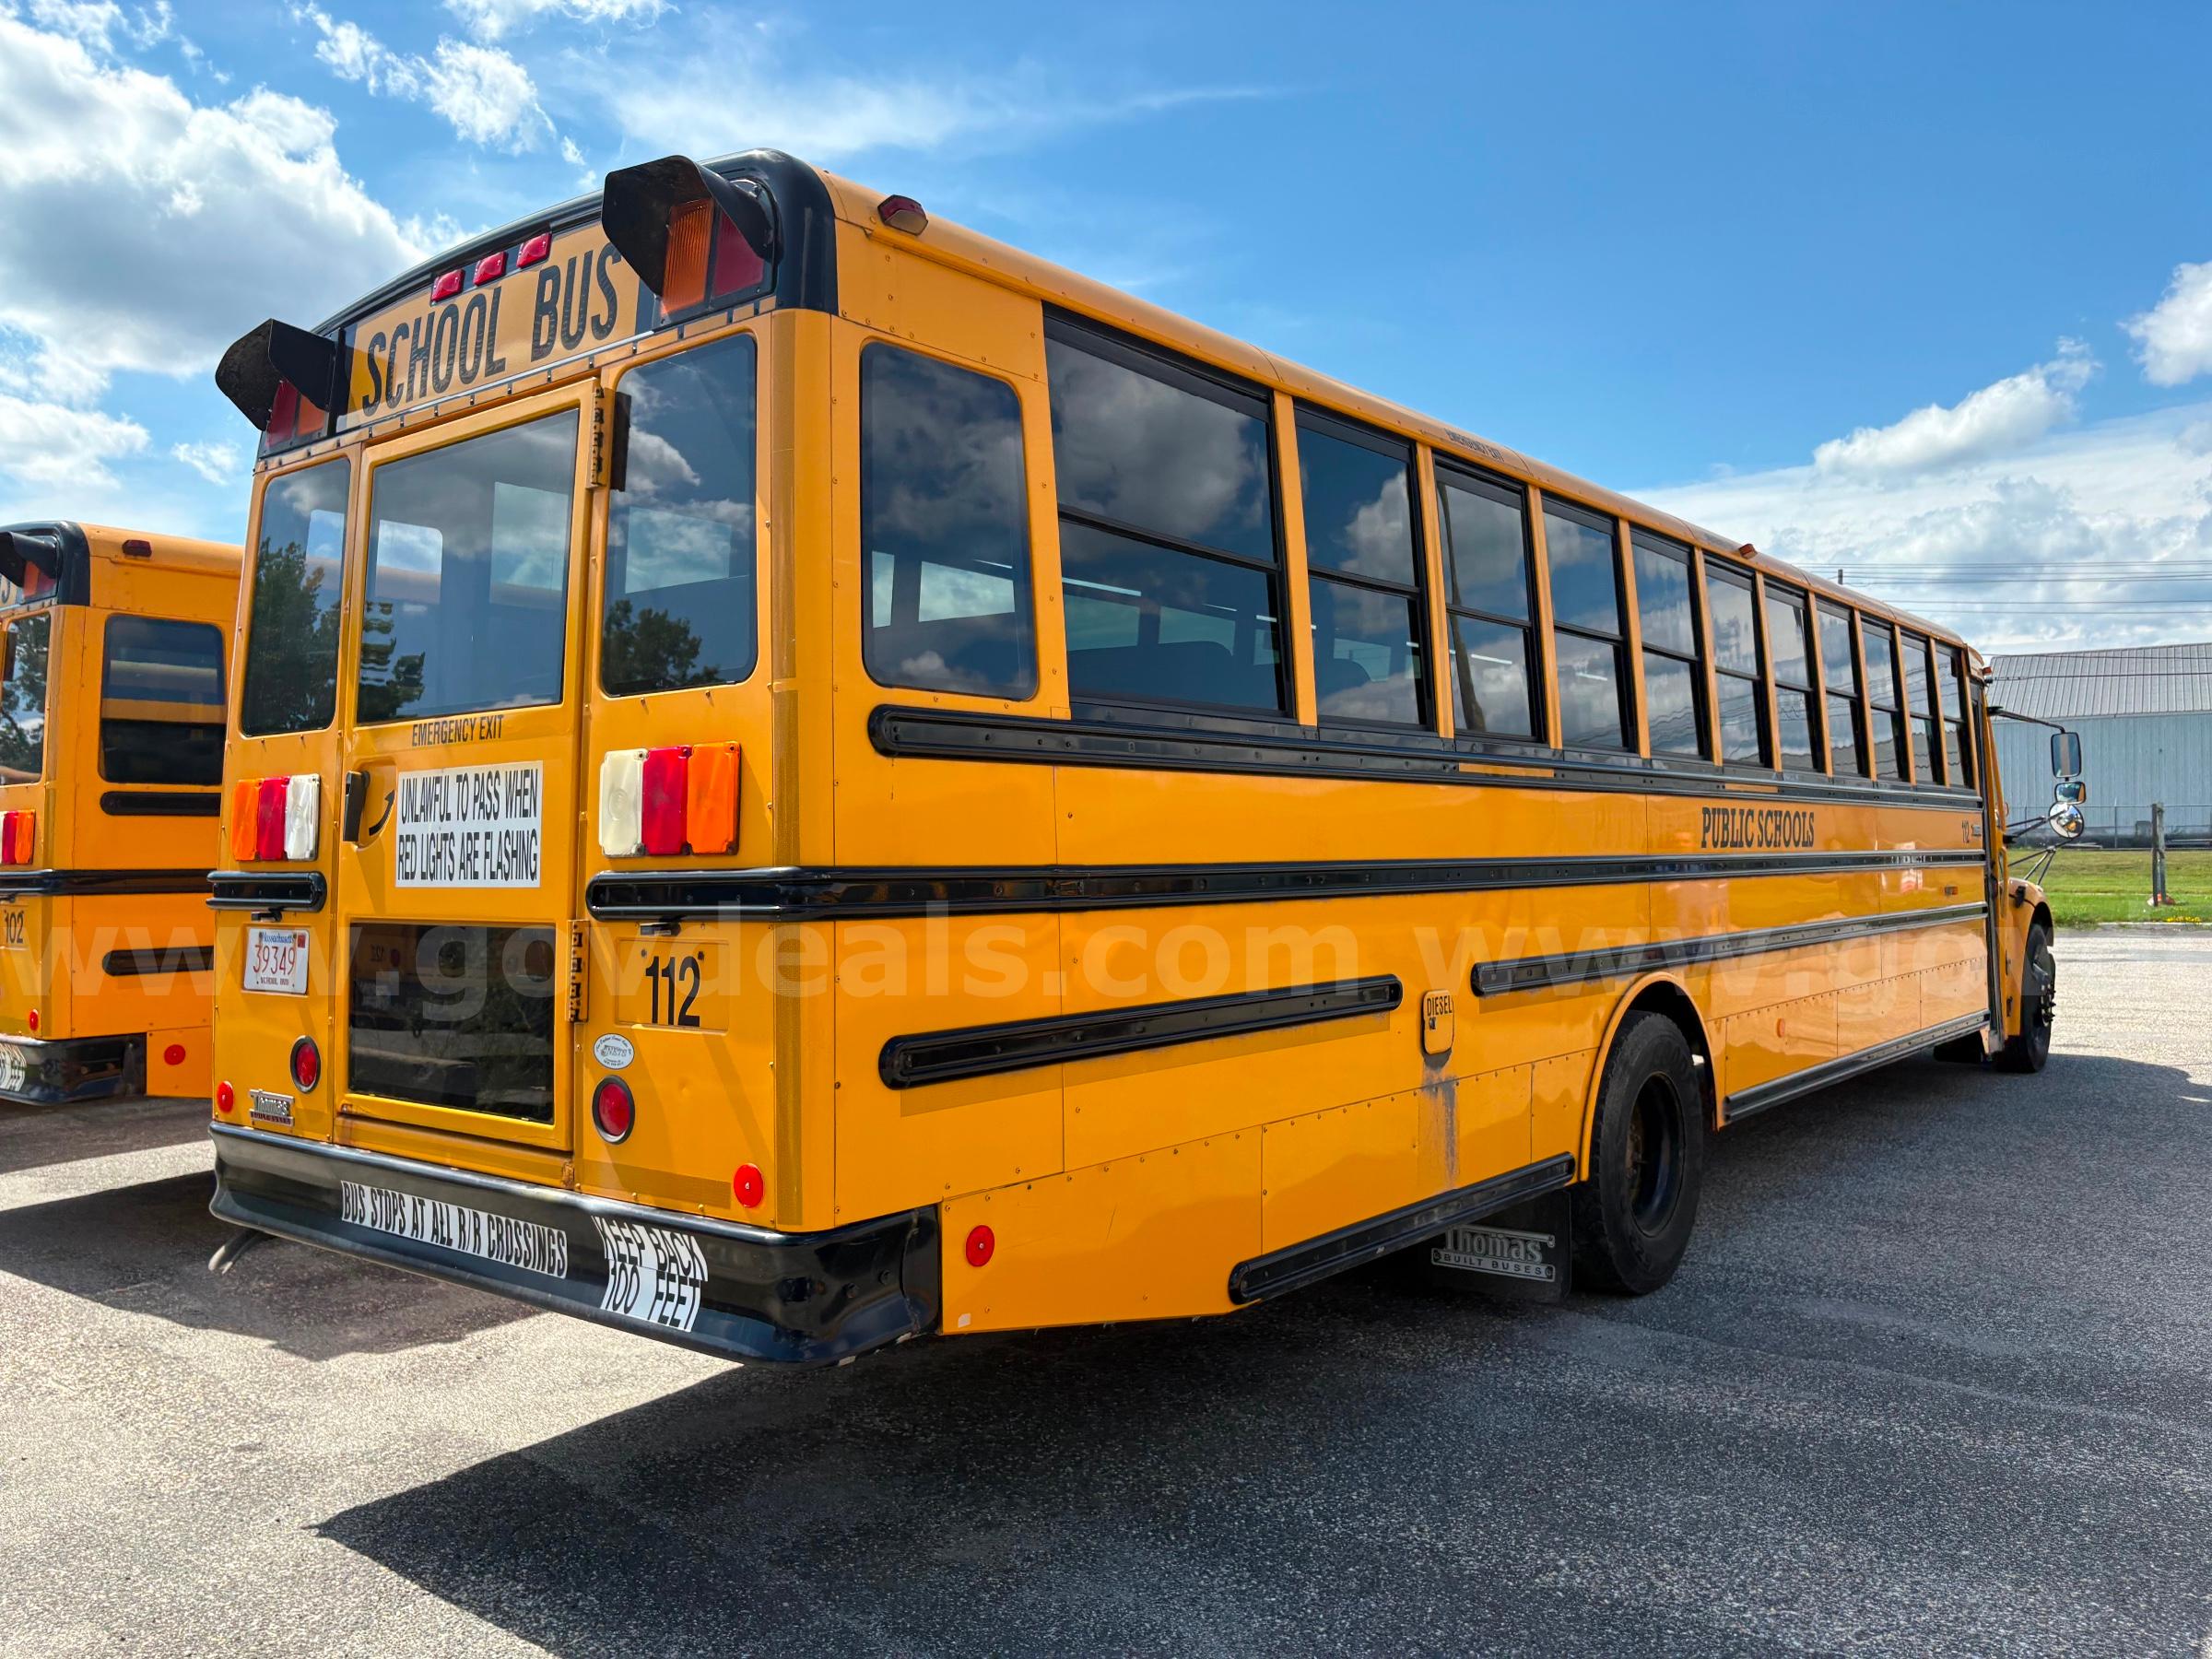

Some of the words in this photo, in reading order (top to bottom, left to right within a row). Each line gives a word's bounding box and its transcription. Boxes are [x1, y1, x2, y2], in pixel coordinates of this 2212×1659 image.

[362, 285, 507, 417] SCHOOL
[531, 242, 623, 362] BUS
[411, 718, 477, 747] EMERGENCY
[479, 714, 504, 740] EXIT
[401, 775, 452, 824] UNLAWFUL
[455, 772, 470, 822] TO
[472, 770, 501, 821] PASS
[505, 769, 539, 819] WHEN
[1701, 806, 1755, 849] PUBLIC
[1757, 809, 1815, 848] SCHOOLS
[397, 833, 417, 881] RED
[420, 831, 455, 882] LIGHTS
[458, 831, 480, 880] ARE
[483, 829, 538, 882] FLASHING
[4, 911, 25, 945] 102
[253, 944, 296, 976] 39349
[645, 956, 700, 1028] 112
[1426, 994, 1453, 1017] DIESEL
[343, 1182, 366, 1222] BUS
[371, 1187, 406, 1235] STOPS
[410, 1196, 426, 1240] AT
[430, 1201, 453, 1247] ALL
[457, 1206, 482, 1254] R/R
[487, 1214, 567, 1277] CROSSINGS
[592, 1216, 646, 1266] KEEP
[649, 1228, 706, 1282] BACK
[1444, 1225, 1544, 1265] Thomas
[1443, 1253, 1484, 1266] BUILT
[1491, 1261, 1542, 1276] BUSES
[605, 1260, 641, 1314] 100
[647, 1270, 700, 1330] FEET
